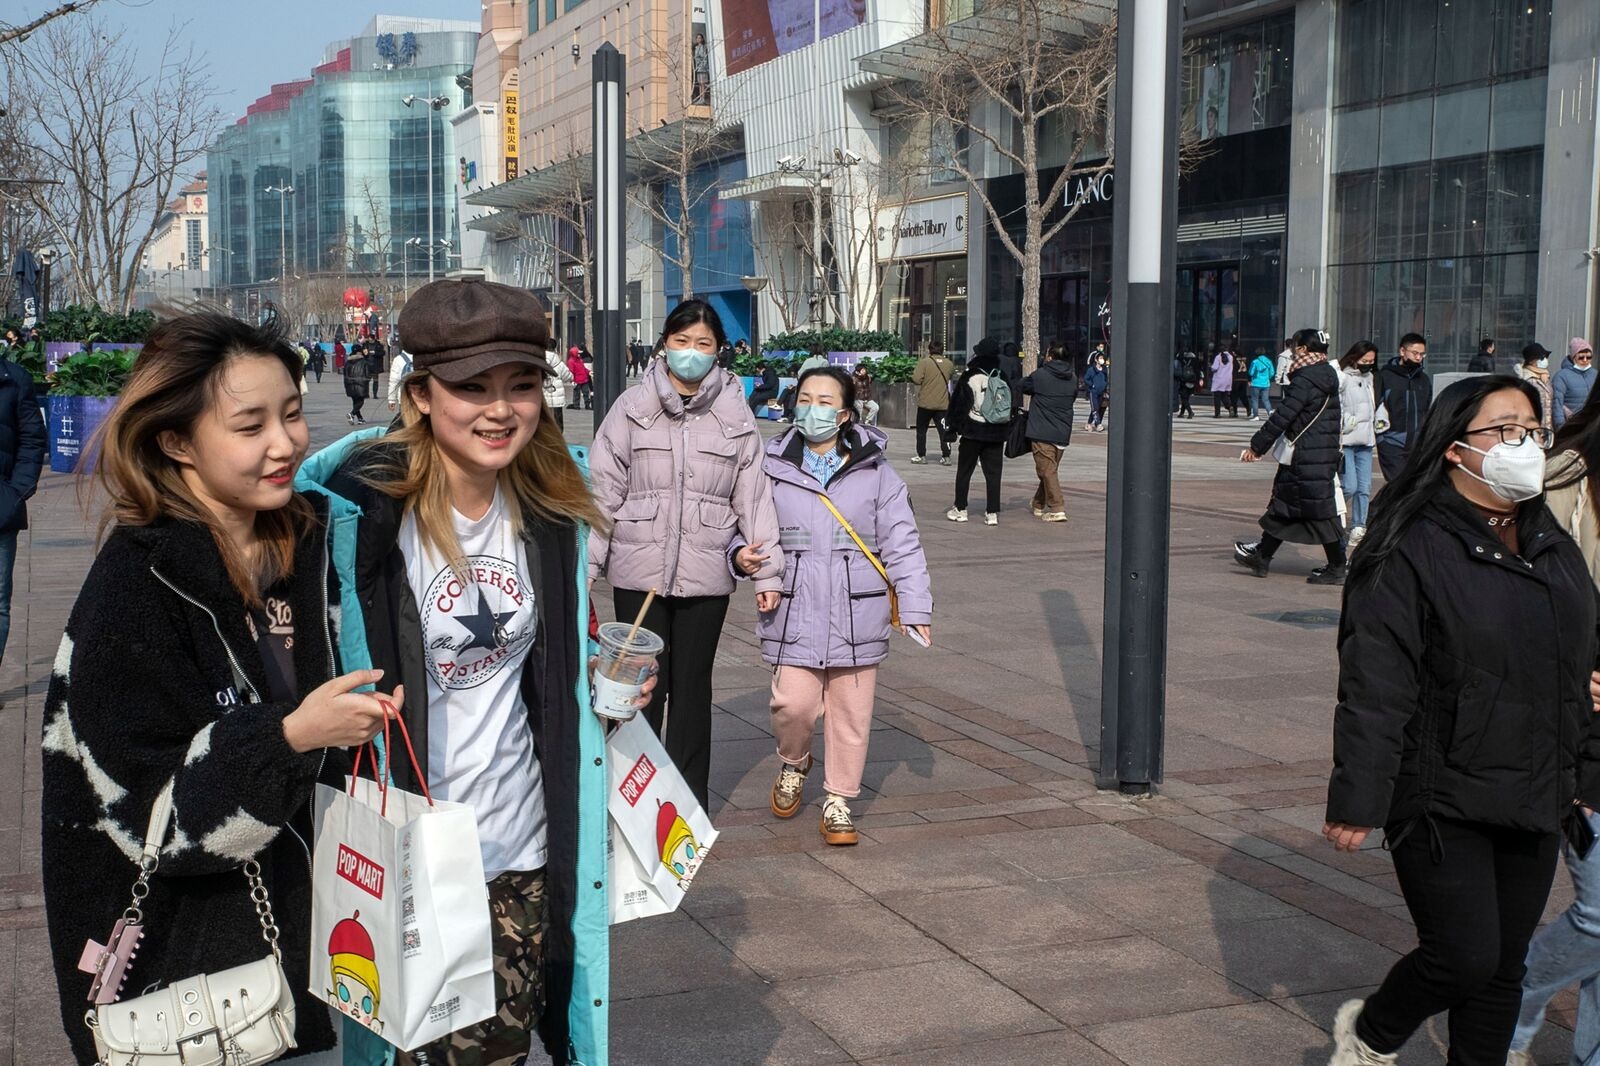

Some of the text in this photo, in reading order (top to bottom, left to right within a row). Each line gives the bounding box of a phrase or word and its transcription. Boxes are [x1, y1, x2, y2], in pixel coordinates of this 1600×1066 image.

[621, 757, 655, 804] POP MART
[339, 848, 383, 894] POP MART
